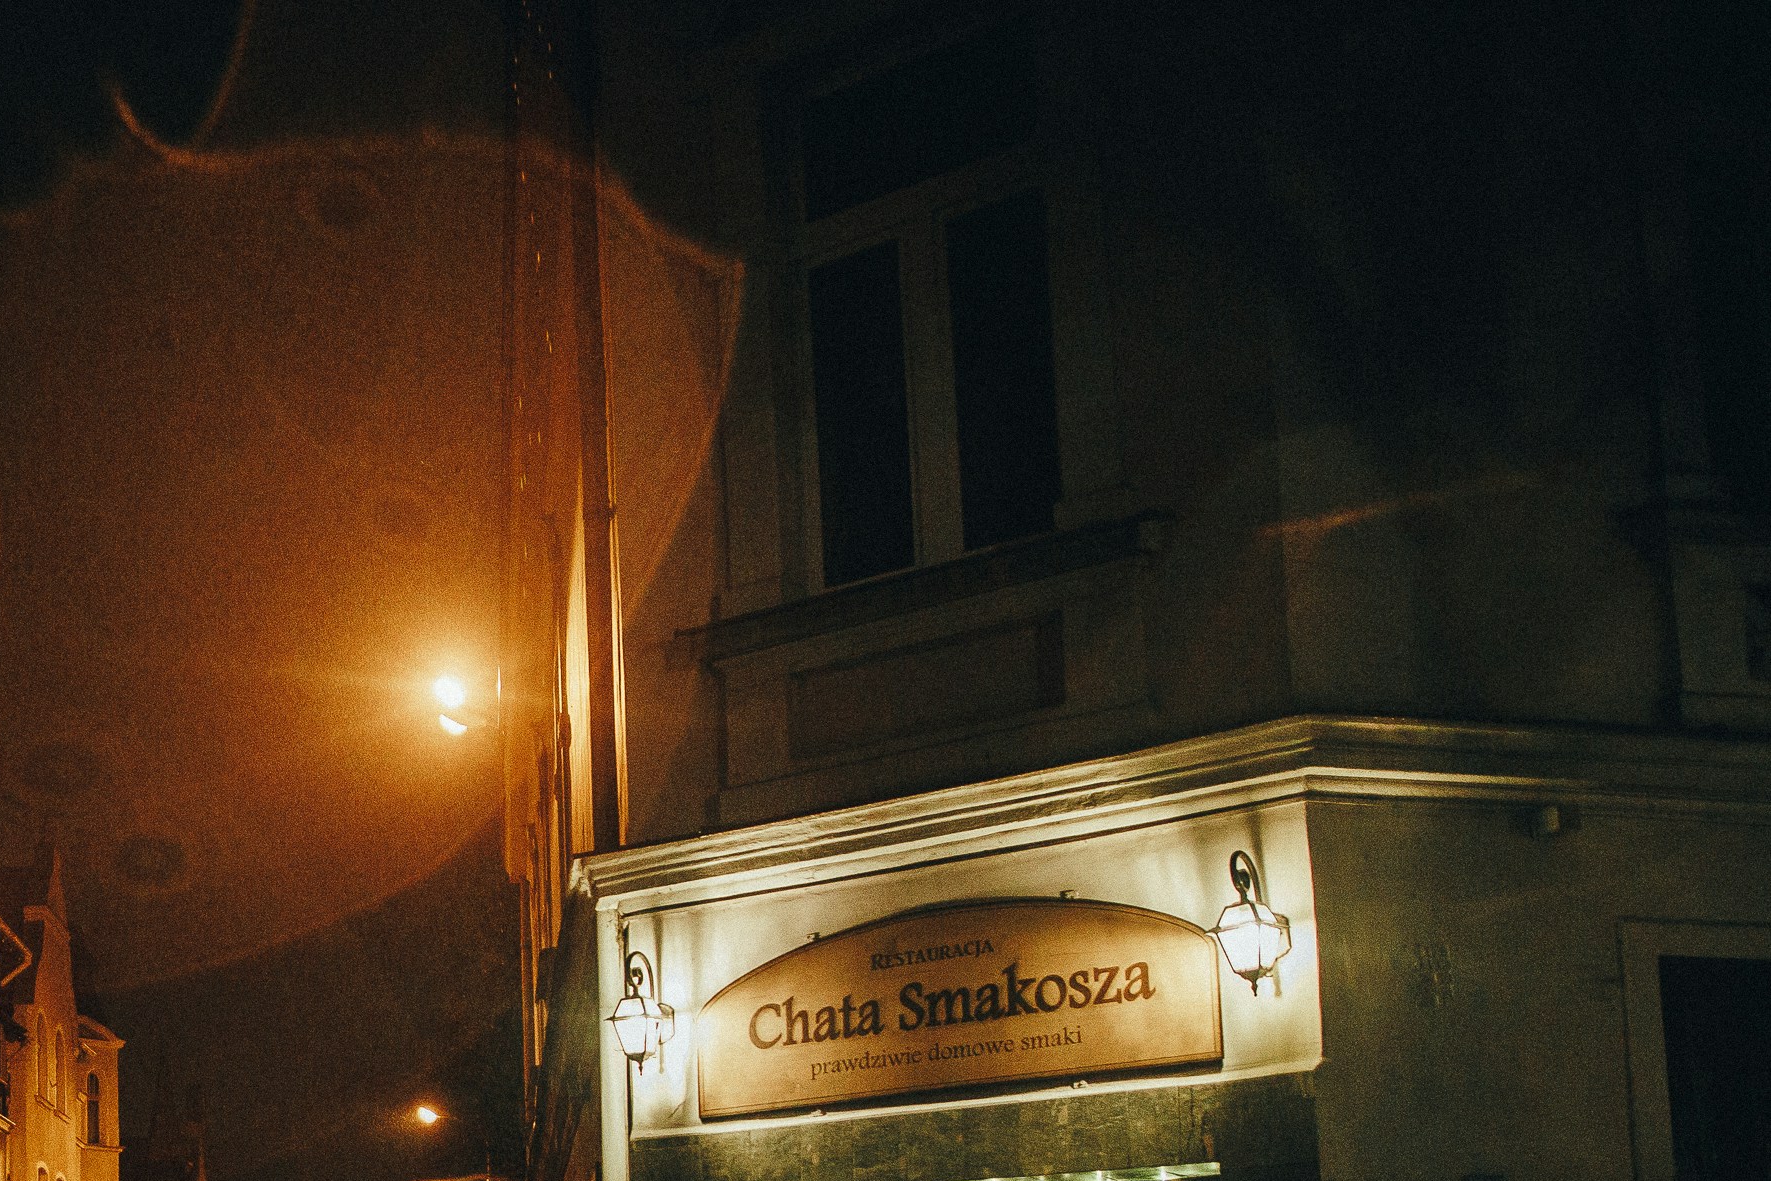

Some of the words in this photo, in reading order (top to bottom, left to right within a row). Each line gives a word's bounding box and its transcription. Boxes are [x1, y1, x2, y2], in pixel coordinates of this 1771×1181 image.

[870, 938, 995, 971] RESTAURACJA
[748, 995, 885, 1050] Chata
[899, 960, 1156, 1032] Smakosza
[810, 1049, 923, 1081] prawdziwie
[928, 1035, 1015, 1063] domowe
[1020, 1025, 1083, 1051] smaki
